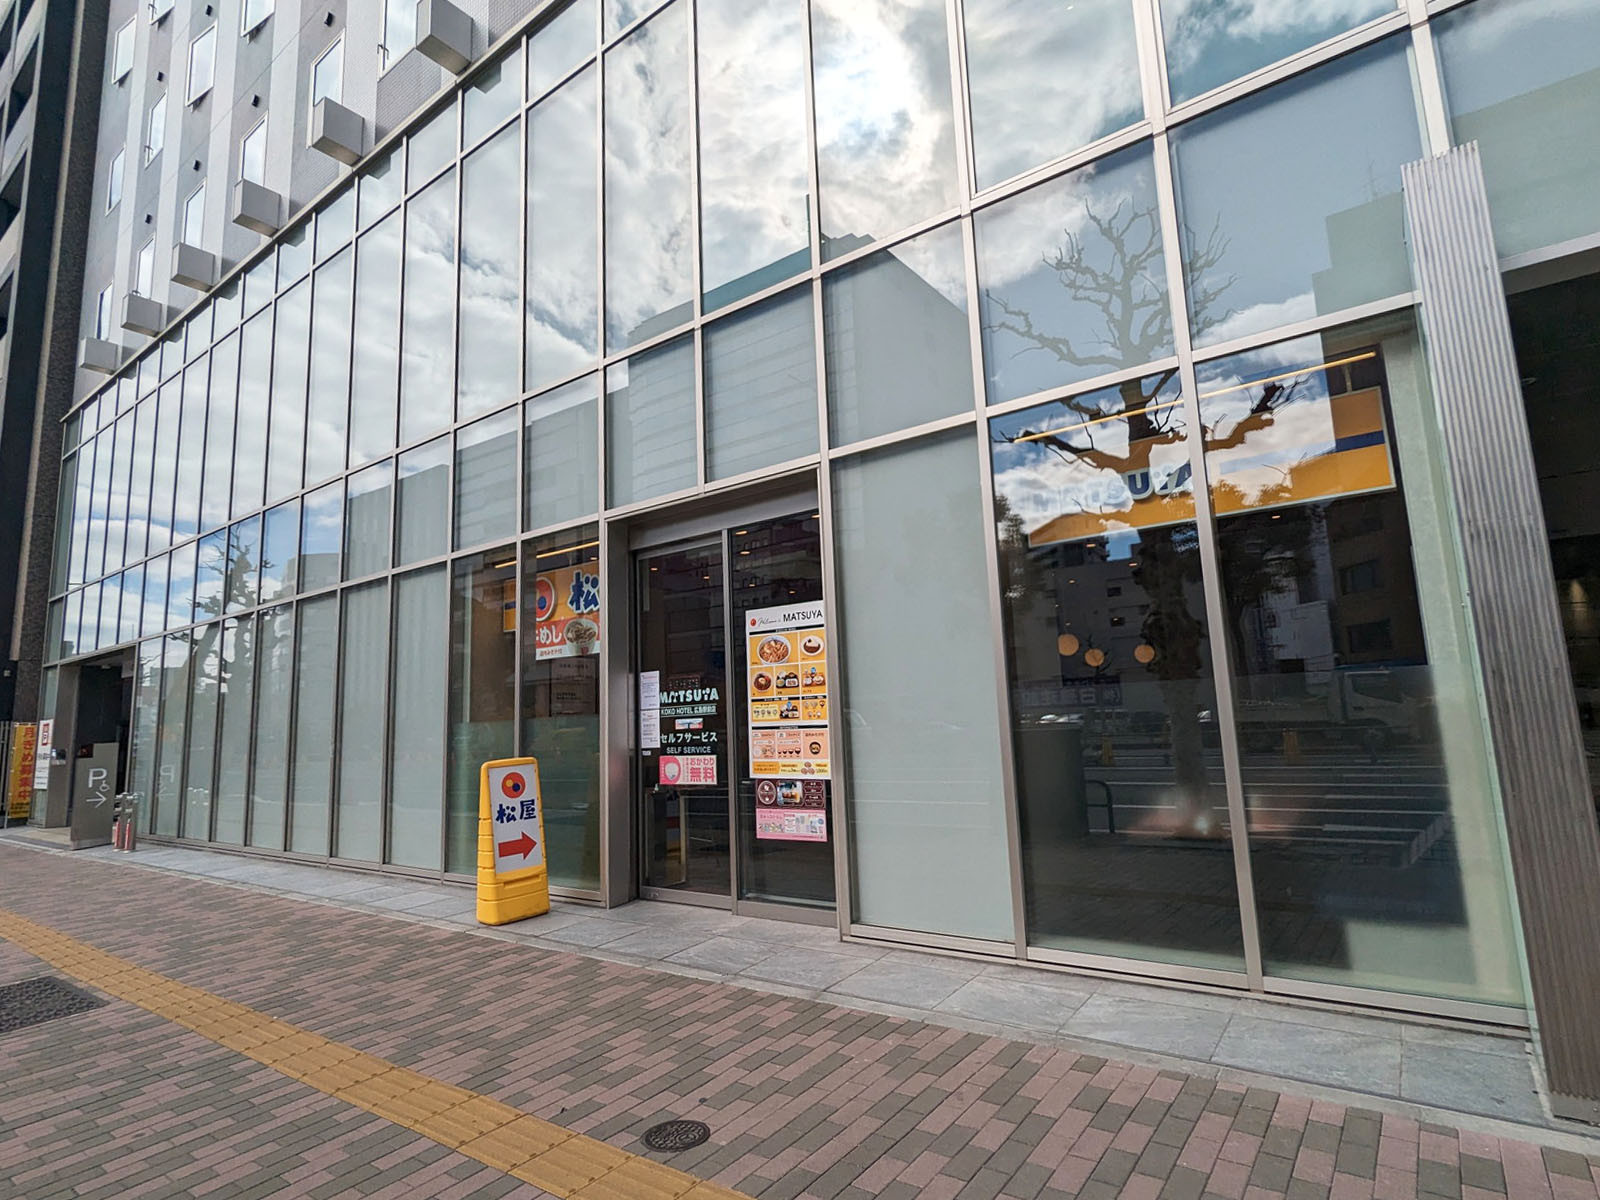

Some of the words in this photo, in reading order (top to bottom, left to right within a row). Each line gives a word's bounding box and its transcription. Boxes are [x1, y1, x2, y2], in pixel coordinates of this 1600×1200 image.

[567, 570, 600, 613] 松
[783, 609, 823, 622] MATSUYA
[536, 624, 562, 645] めし
[676, 706, 693, 714] HOTEL
[660, 731, 718, 743] セルフサービス
[666, 746, 682, 754] SELF
[683, 745, 711, 754] SERVICE
[690, 757, 715, 766] おかわり
[88, 768, 107, 788] P
[690, 767, 715, 782] 無料
[496, 799, 536, 824] 松屋
